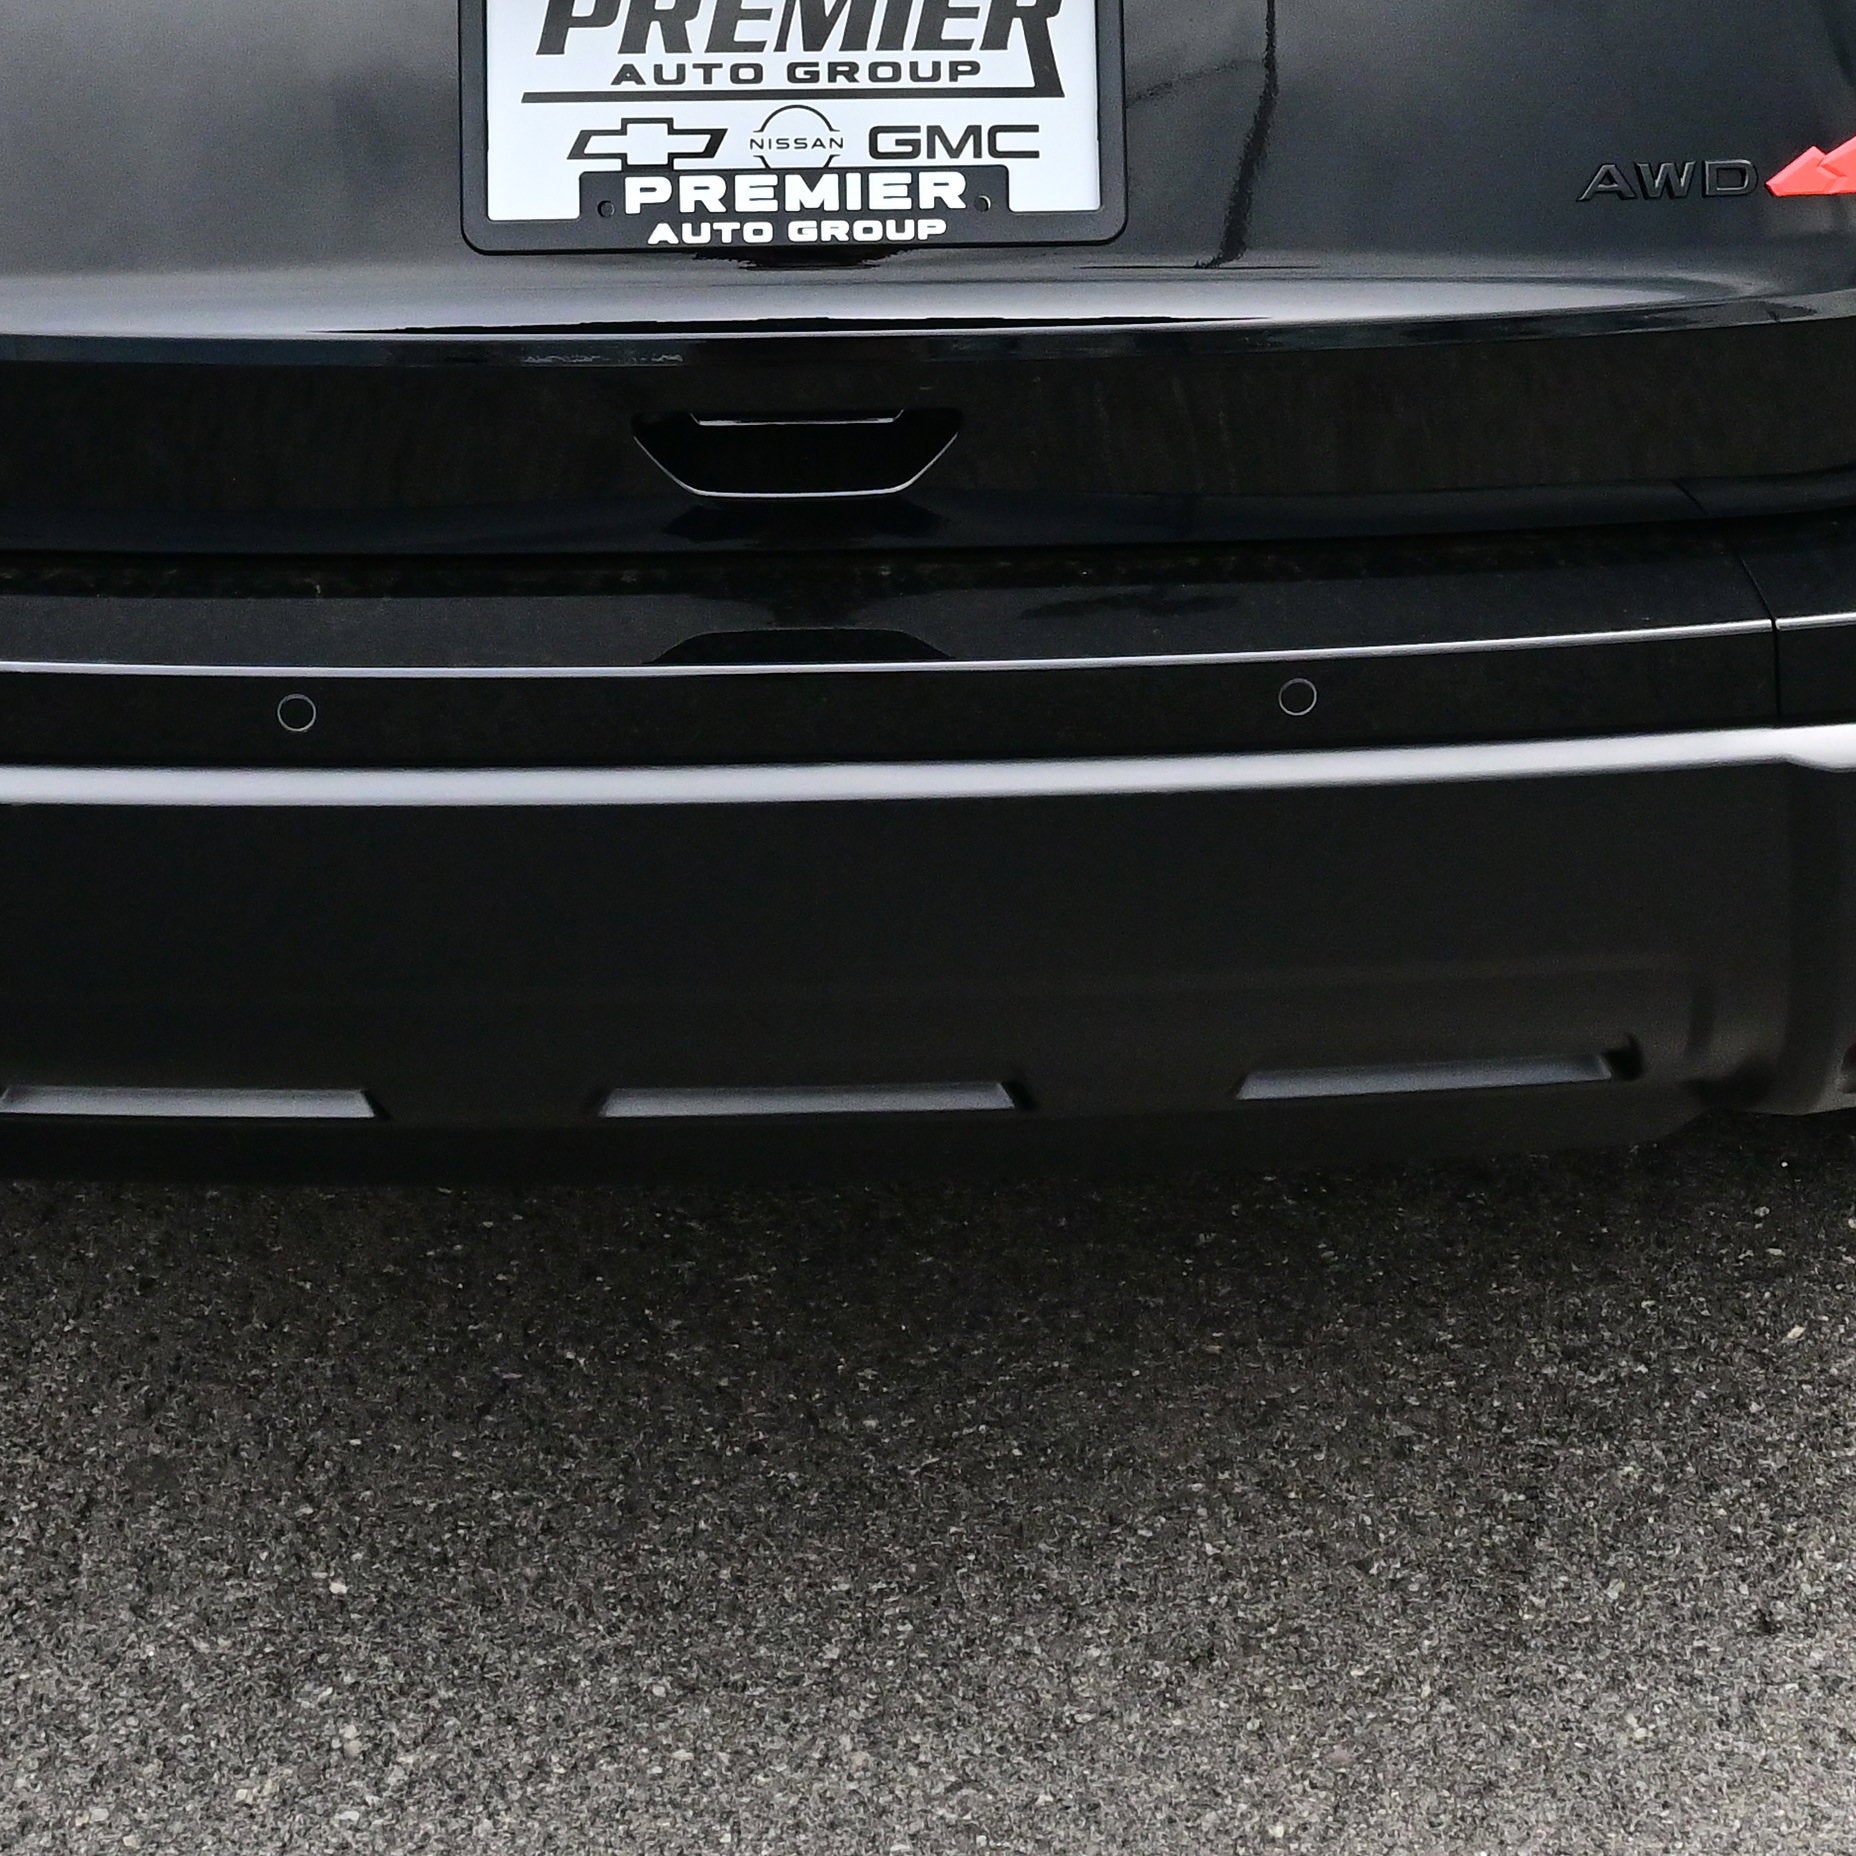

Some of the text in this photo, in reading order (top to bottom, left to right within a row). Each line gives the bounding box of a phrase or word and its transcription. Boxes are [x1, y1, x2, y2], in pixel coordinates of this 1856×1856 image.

[610, 60, 981, 86] AUTO GROUP
[750, 135, 845, 151] NISSAN
[869, 124, 1040, 159] GMC
[625, 171, 967, 215] PREMIER
[1576, 158, 1758, 201] AWD
[648, 218, 947, 245] AUTO GROUP
